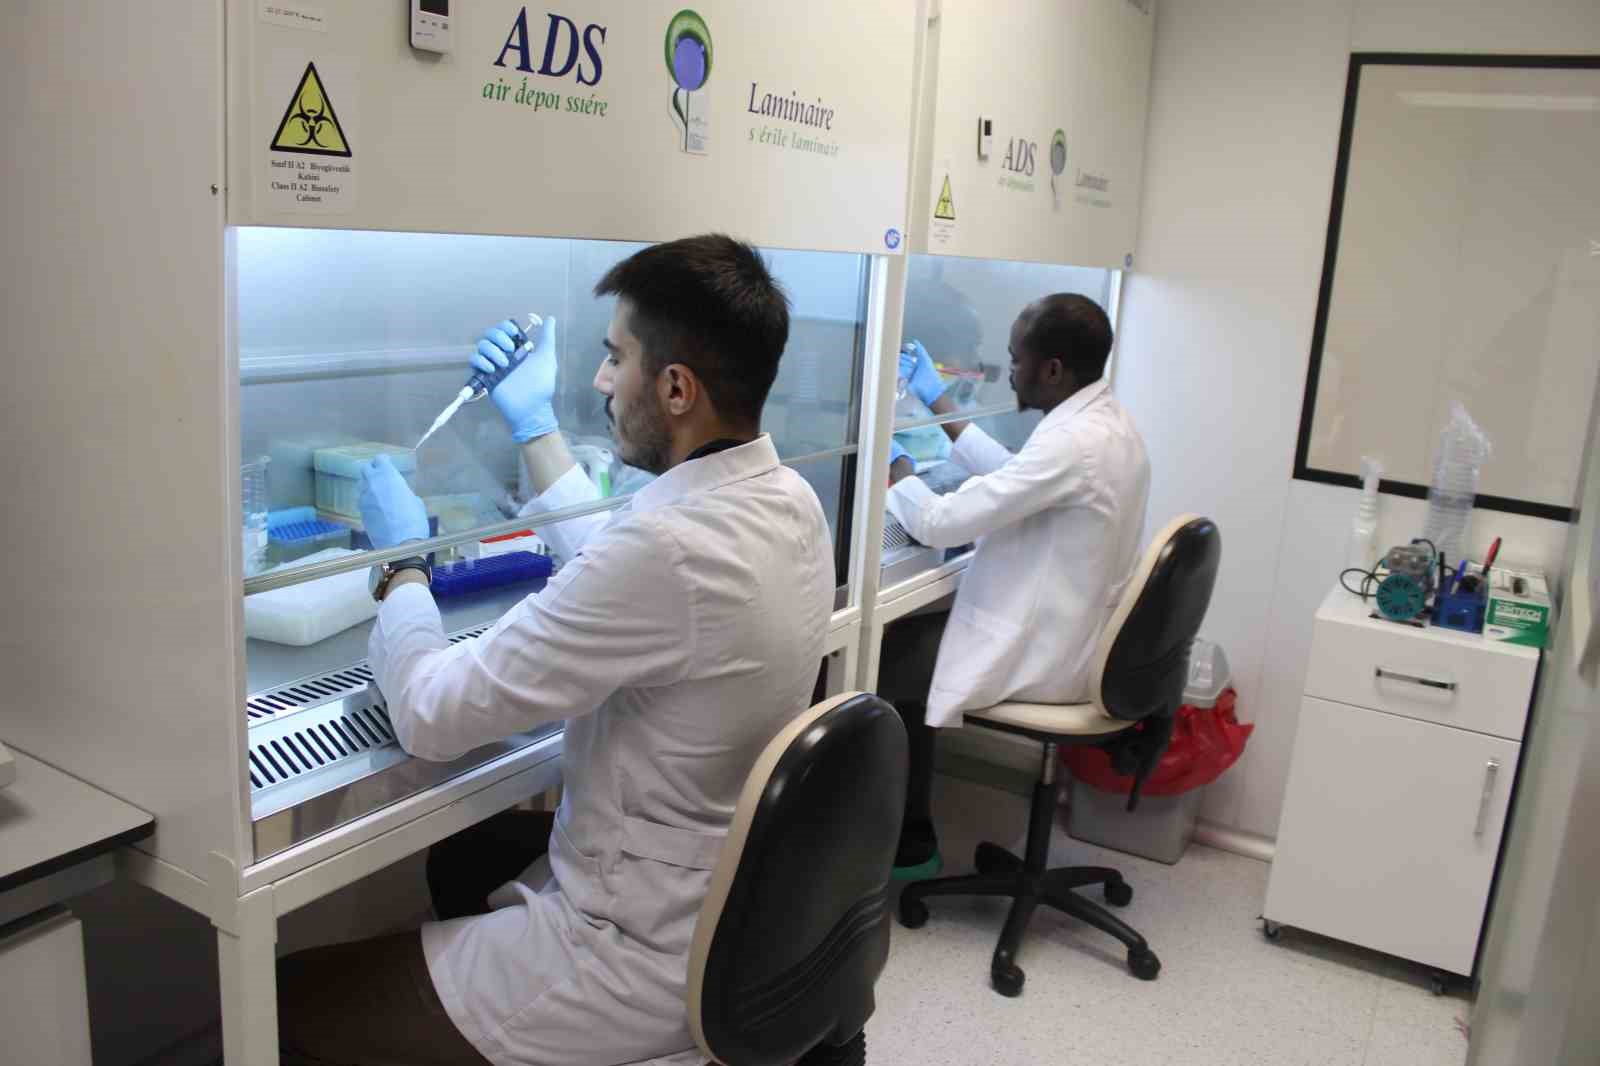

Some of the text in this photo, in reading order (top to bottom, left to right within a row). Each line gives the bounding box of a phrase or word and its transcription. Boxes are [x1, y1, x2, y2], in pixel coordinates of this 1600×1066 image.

[493, 5, 607, 87] ADS
[482, 77, 511, 101] air
[748, 82, 834, 130] Laminaire
[1001, 137, 1037, 177] ADS
